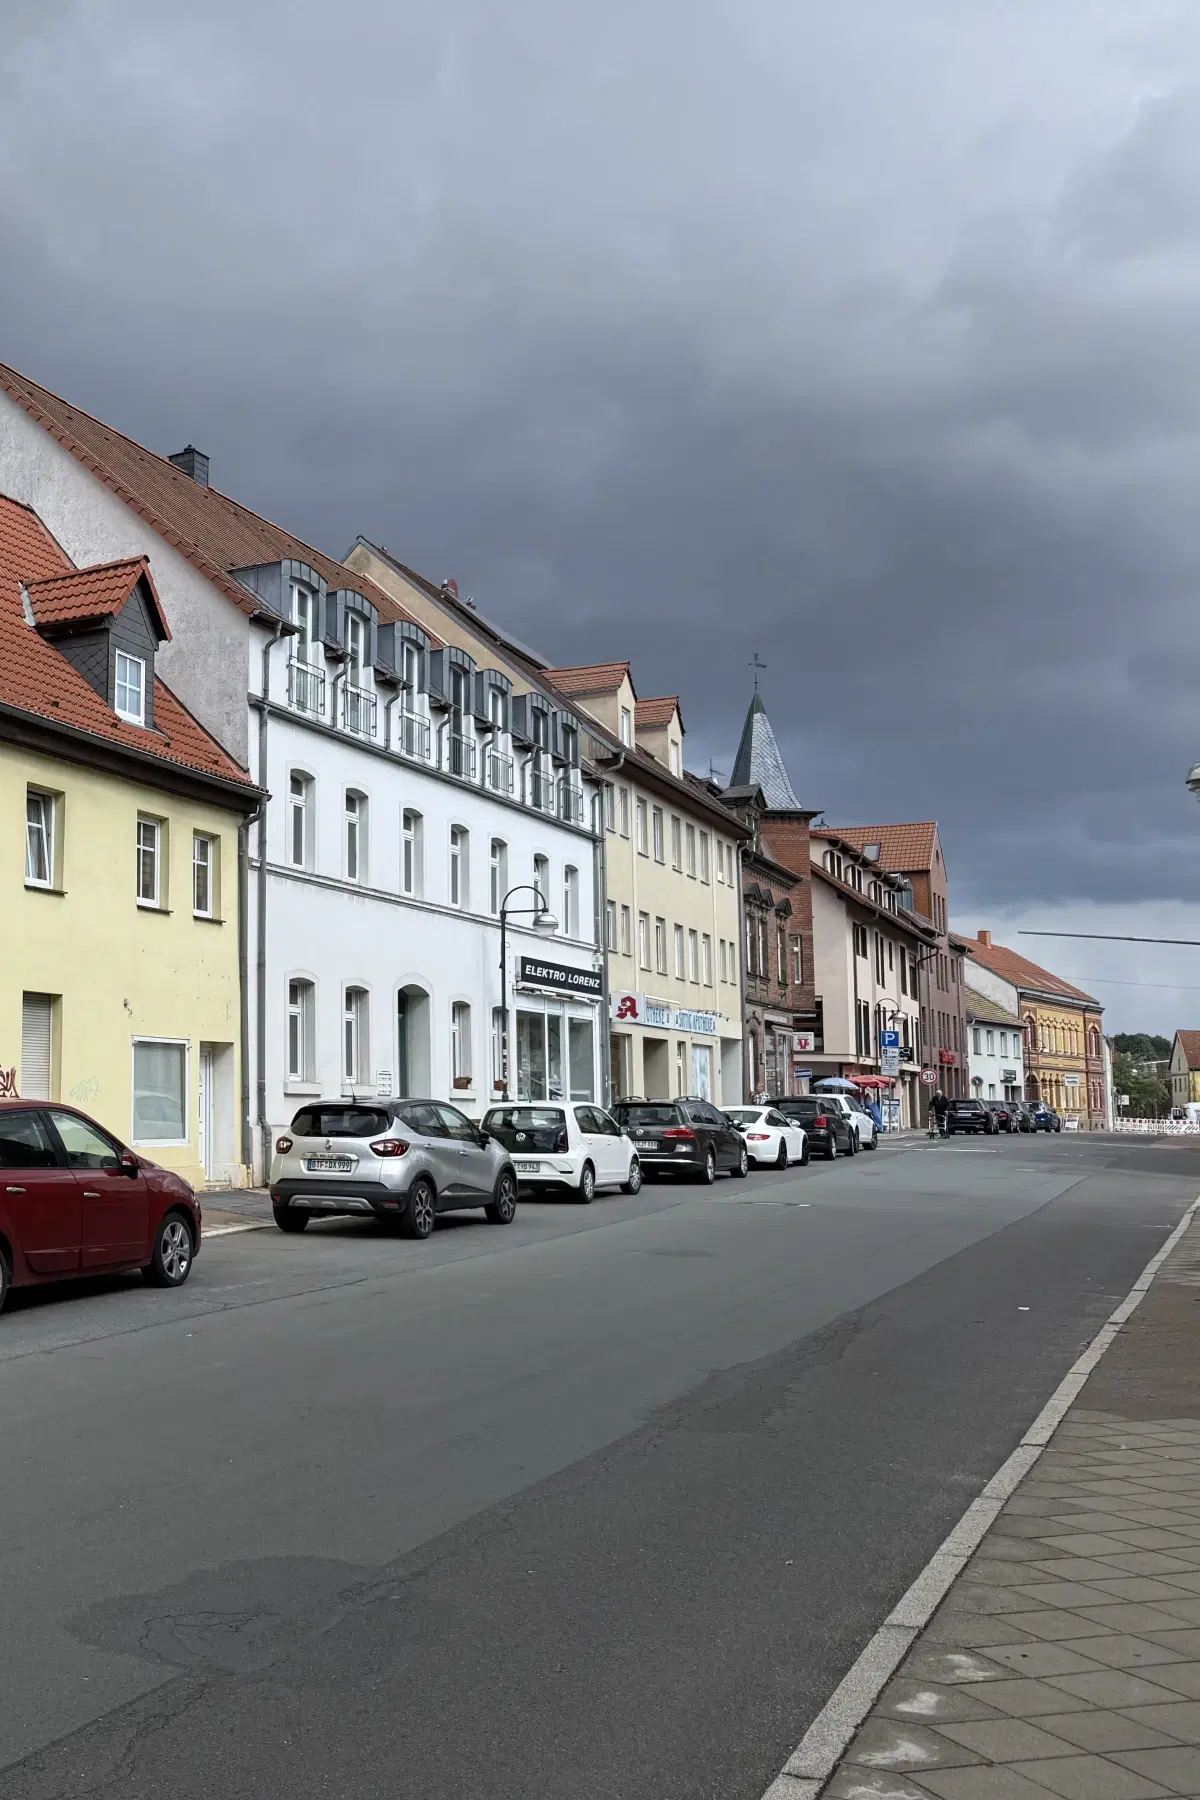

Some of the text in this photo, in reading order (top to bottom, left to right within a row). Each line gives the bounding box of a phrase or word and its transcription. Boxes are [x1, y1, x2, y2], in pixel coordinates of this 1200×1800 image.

[525, 964, 600, 989] ELEKTRO LORENZ
[884, 1032, 896, 1045] P
[924, 1072, 935, 1081] 30
